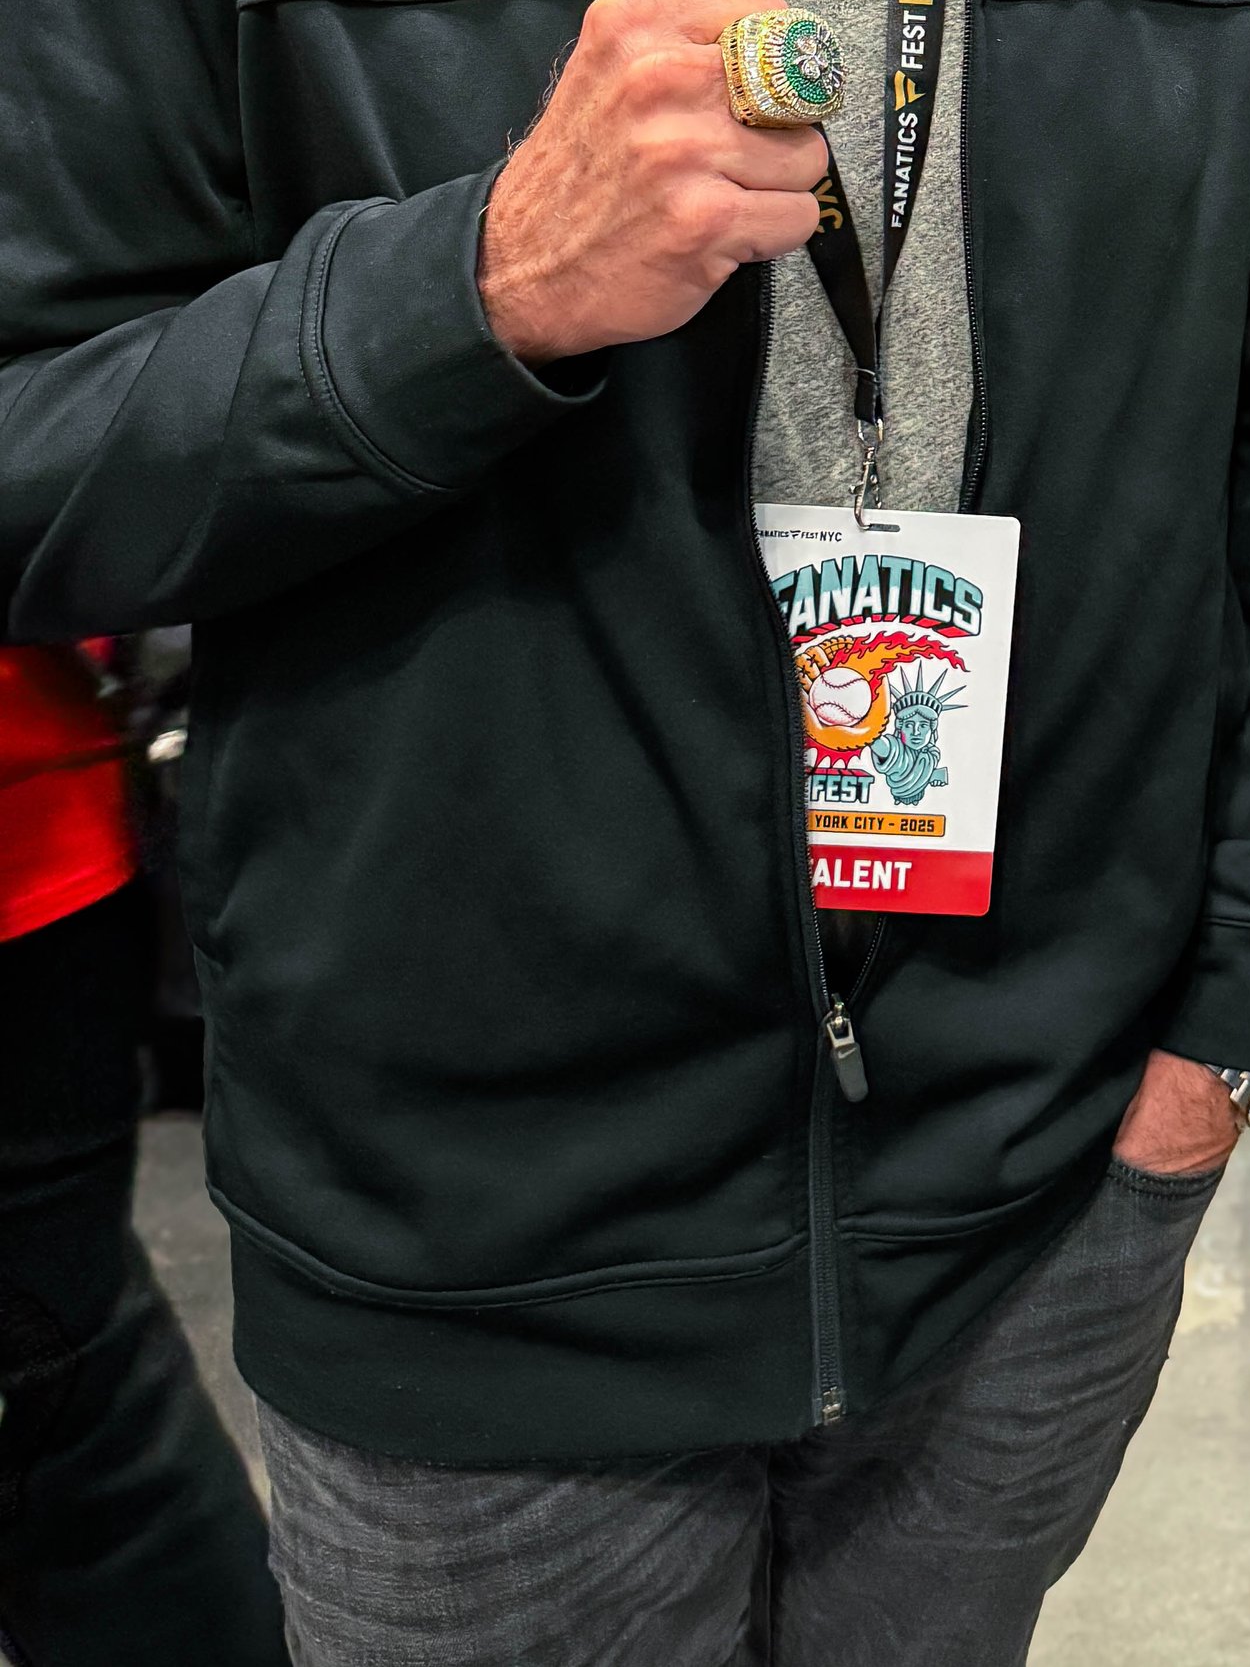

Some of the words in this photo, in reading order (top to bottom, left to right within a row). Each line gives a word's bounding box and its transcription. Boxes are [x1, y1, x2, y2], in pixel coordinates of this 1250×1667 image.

[901, 9, 928, 71] FEST
[890, 111, 919, 229] FANATICS
[819, 530, 843, 543] NYC
[810, 771, 875, 805] FEST
[815, 814, 850, 830] YORK
[854, 815, 885, 831] CITY
[900, 818, 935, 833] 2025
[811, 857, 913, 891] ALENT
